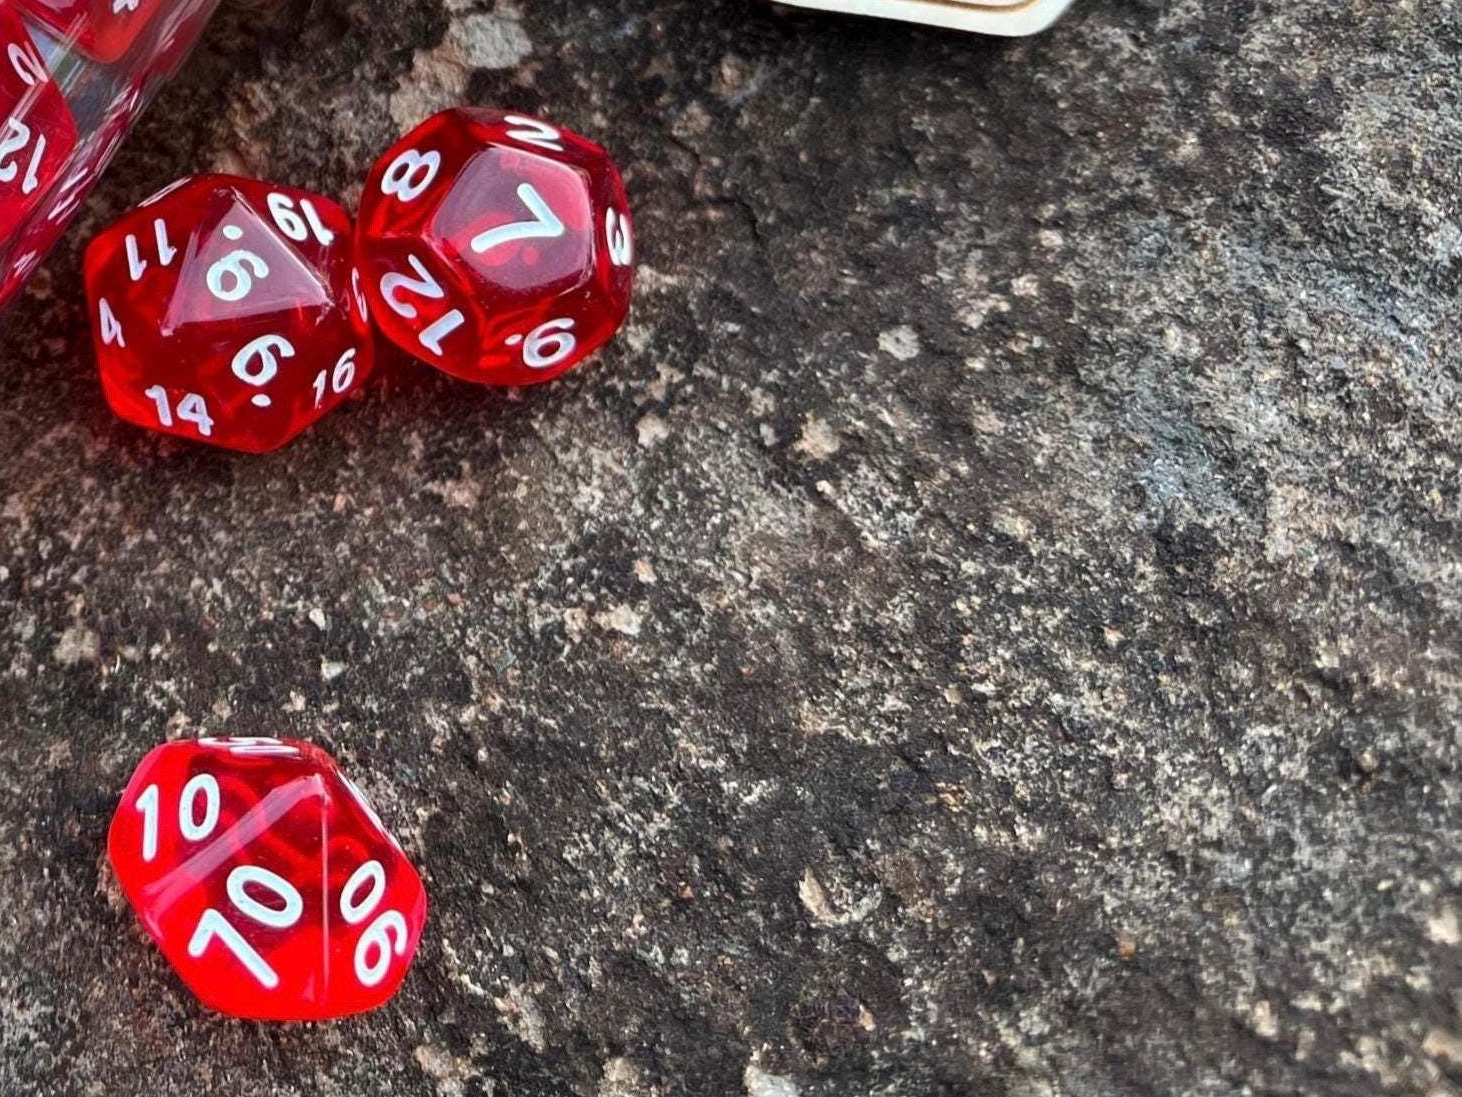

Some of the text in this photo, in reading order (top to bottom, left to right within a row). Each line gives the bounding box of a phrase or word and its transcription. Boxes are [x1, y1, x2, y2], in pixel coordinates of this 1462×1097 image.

[380, 148, 442, 202] 8
[125, 218, 178, 282] 11
[265, 192, 334, 247] 19
[470, 183, 565, 254] 7
[98, 296, 126, 348] 4
[379, 253, 465, 357] 12
[312, 347, 356, 409] 16
[144, 383, 214, 438] 14
[135, 773, 220, 862] 10
[187, 865, 303, 988] 70
